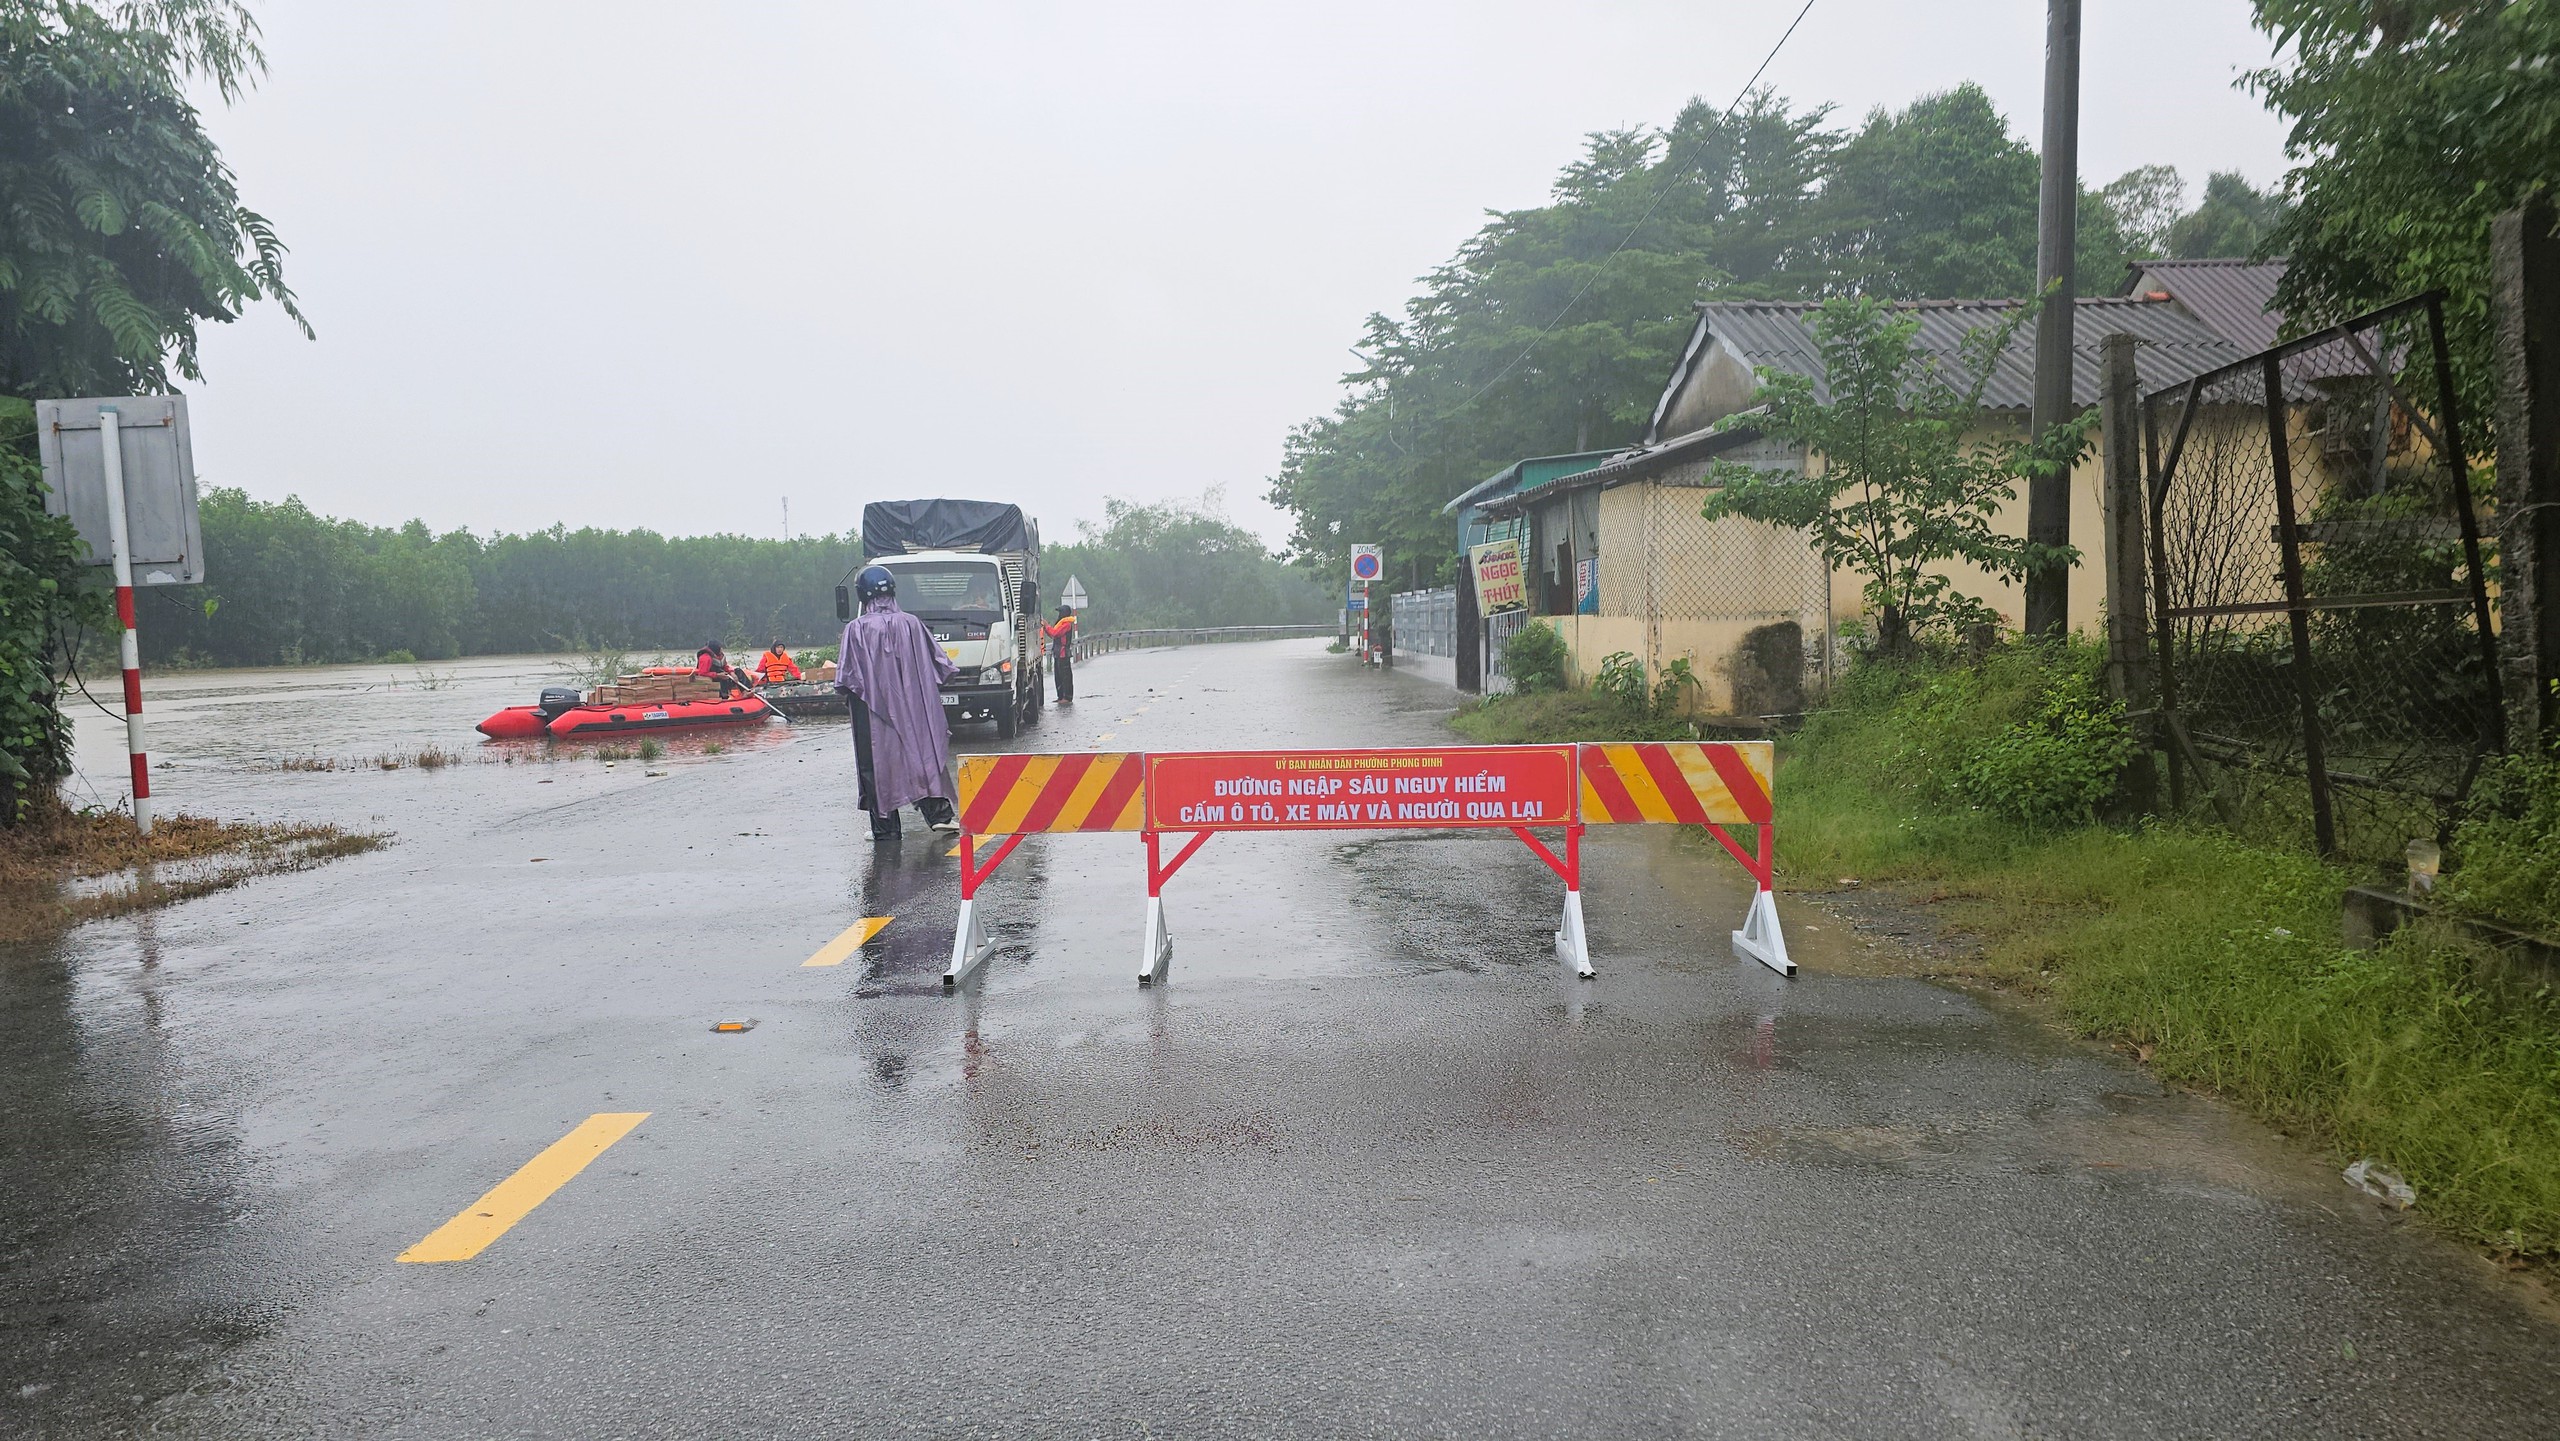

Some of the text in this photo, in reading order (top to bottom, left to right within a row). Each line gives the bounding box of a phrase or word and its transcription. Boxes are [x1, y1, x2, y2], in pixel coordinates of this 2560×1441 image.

[1357, 546, 1376, 554] ZONE
[1480, 562, 1519, 581] NGỌC
[1483, 582, 1520, 604] THÚY
[934, 633, 949, 641] ZU
[1289, 759, 1306, 770] BAN
[1308, 758, 1332, 770] NHÂN
[1334, 757, 1352, 769] DÂN
[1354, 756, 1388, 768] PHƯỜNG
[1390, 757, 1420, 768] PHONG
[1214, 769, 1506, 799] ĐƯỜNG NGẬP SÂU NGUY HIỂM
[1180, 798, 1543, 824] CẤM Ô TÔ, XE MÁY VÀ NGƯỜI QUA LẠI
